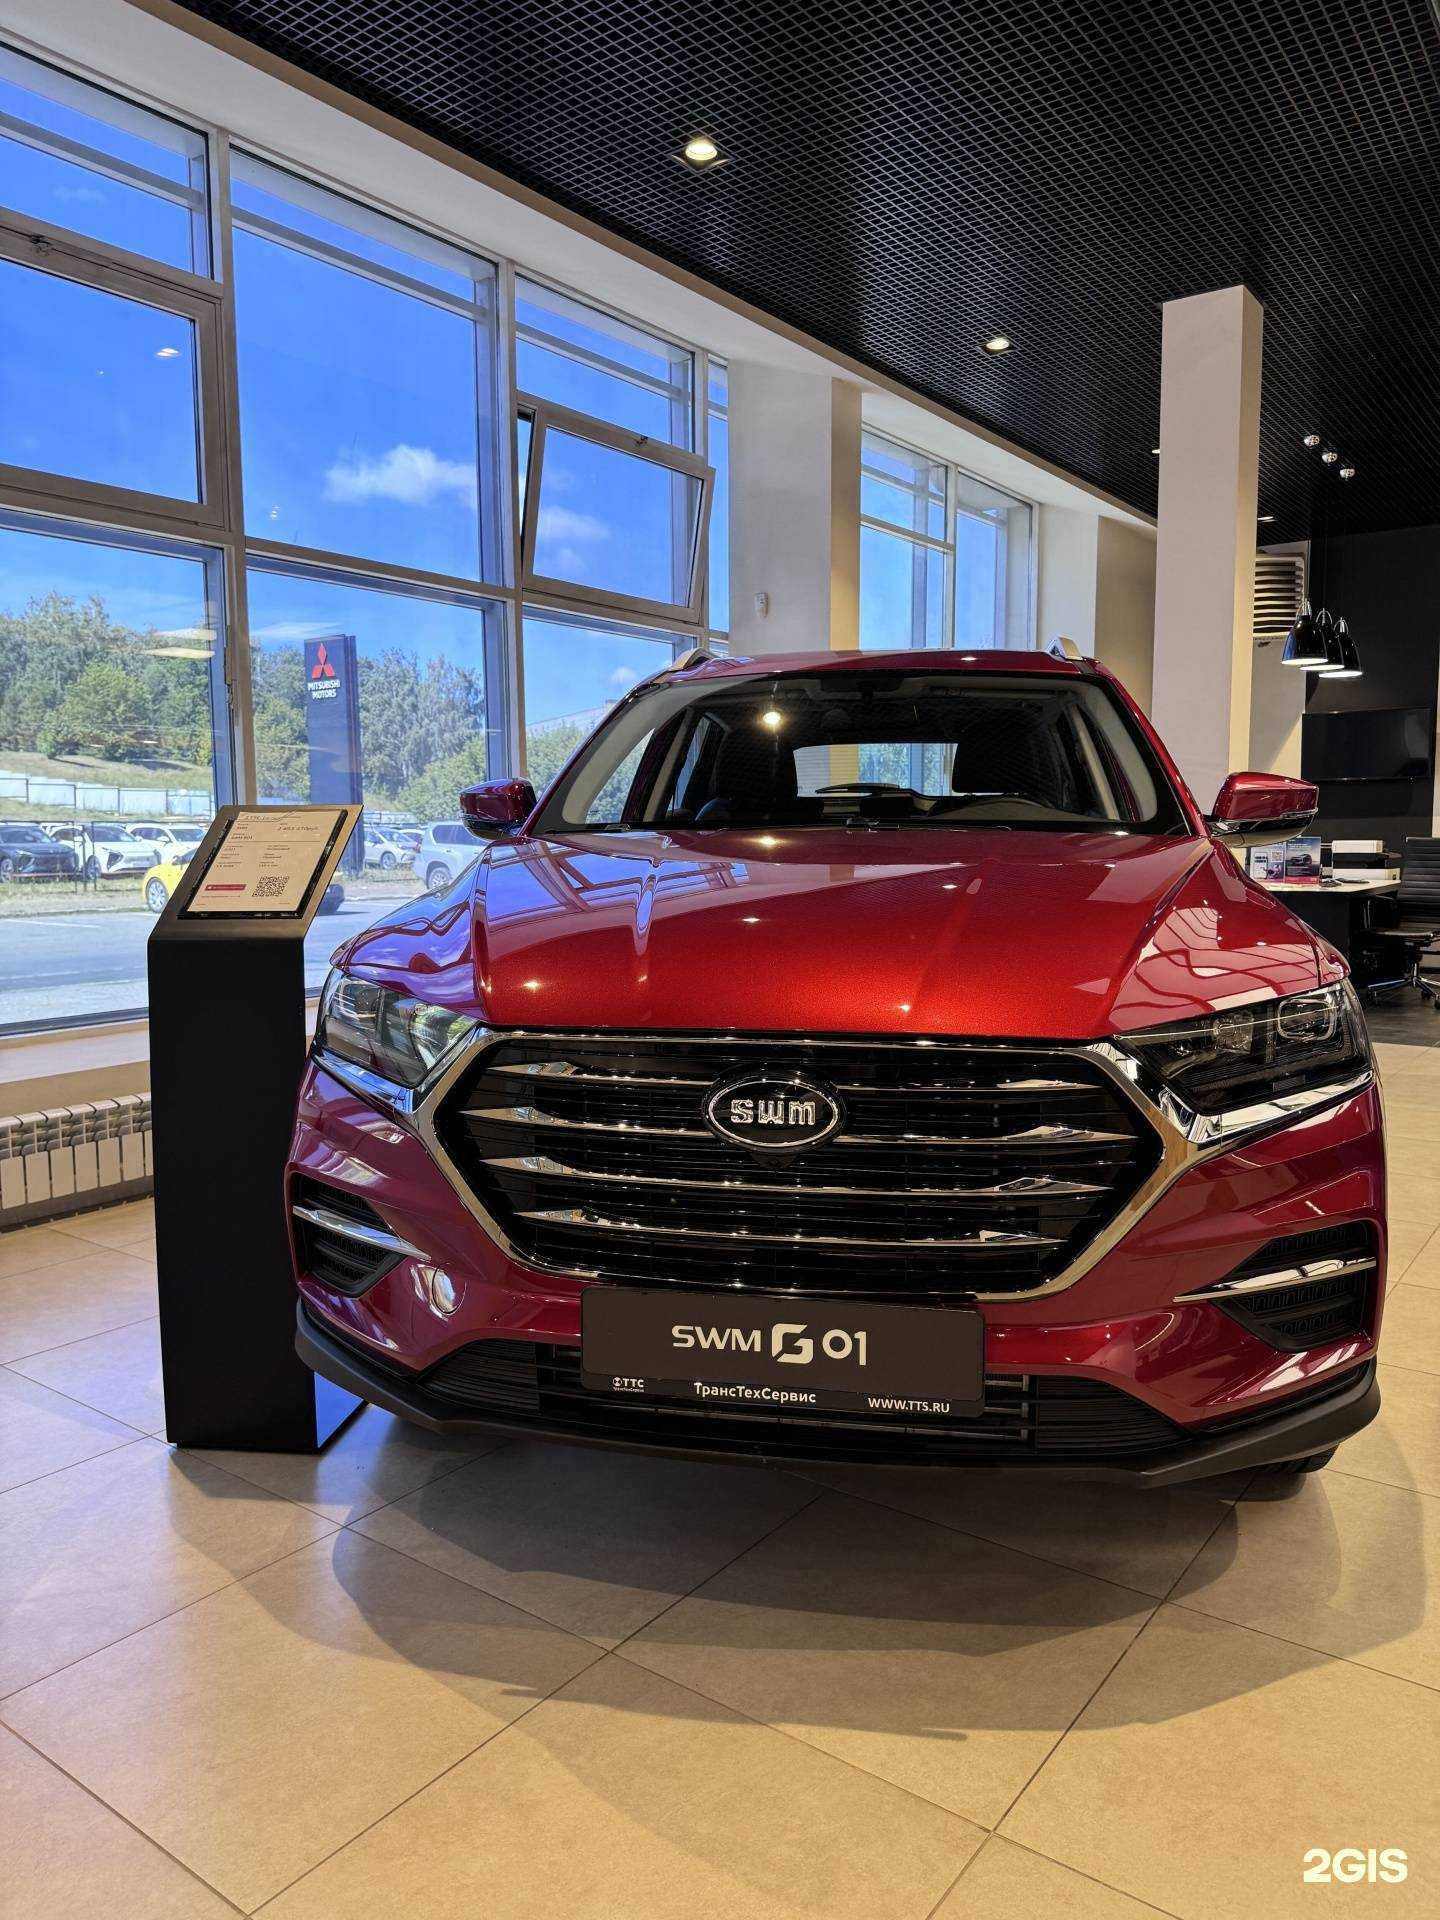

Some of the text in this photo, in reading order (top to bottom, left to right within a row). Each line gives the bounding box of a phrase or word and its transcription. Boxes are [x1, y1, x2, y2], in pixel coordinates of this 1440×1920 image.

[308, 680, 340, 690] MITSUBISHI
[312, 689, 337, 699] MOTORS
[671, 1325, 761, 1352] SWM
[693, 1382, 816, 1403] ТрансТехСервис
[868, 1397, 950, 1413] WWW.TTS.RU
